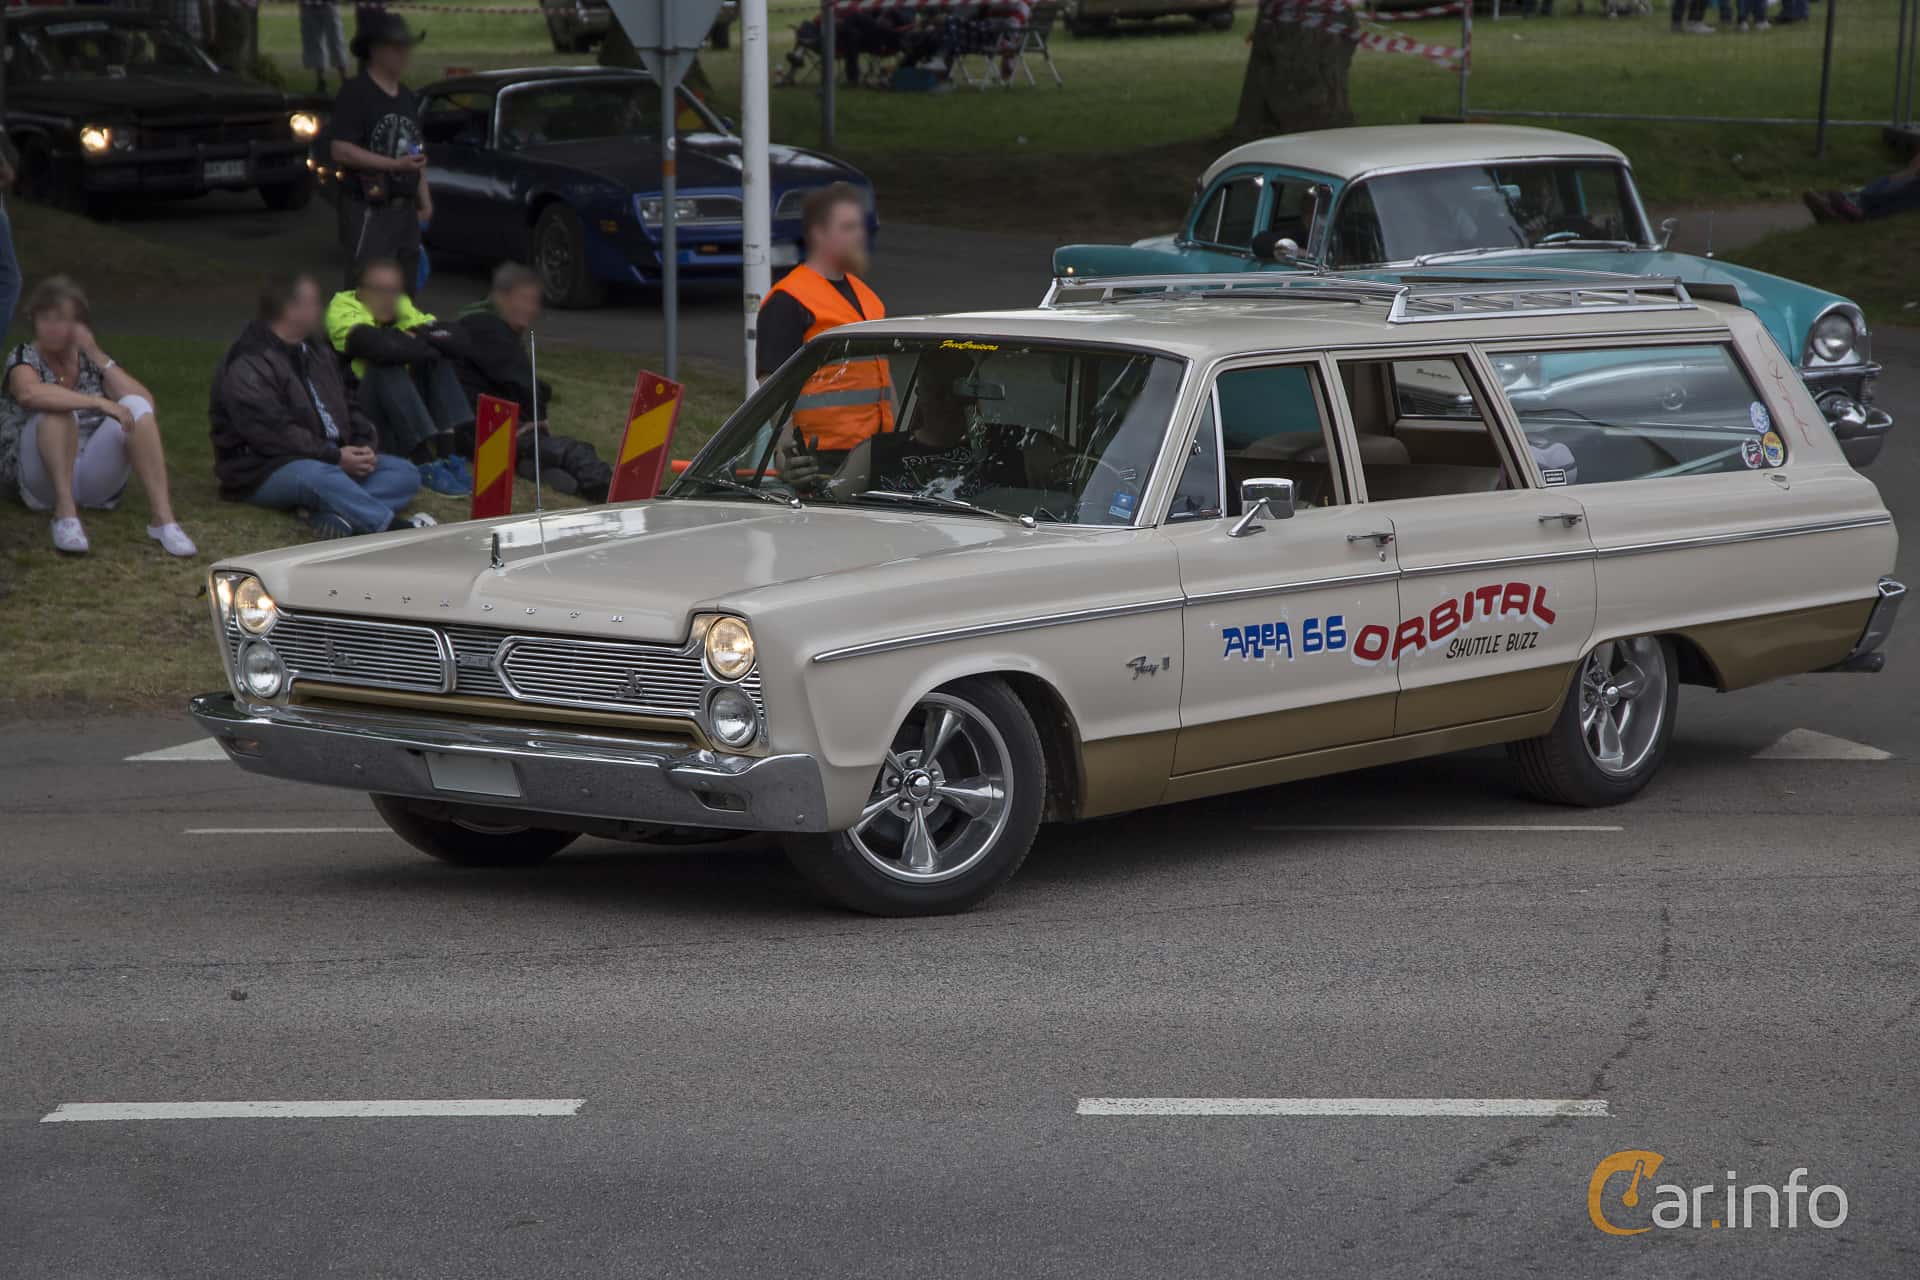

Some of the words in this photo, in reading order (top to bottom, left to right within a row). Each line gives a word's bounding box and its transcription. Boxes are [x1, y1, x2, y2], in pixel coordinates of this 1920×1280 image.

[1303, 615, 1347, 653] 66
[1354, 582, 1556, 662] ORBITAL
[1447, 634, 1500, 659] SHUTTLE
[1506, 631, 1539, 651] BUZZ
